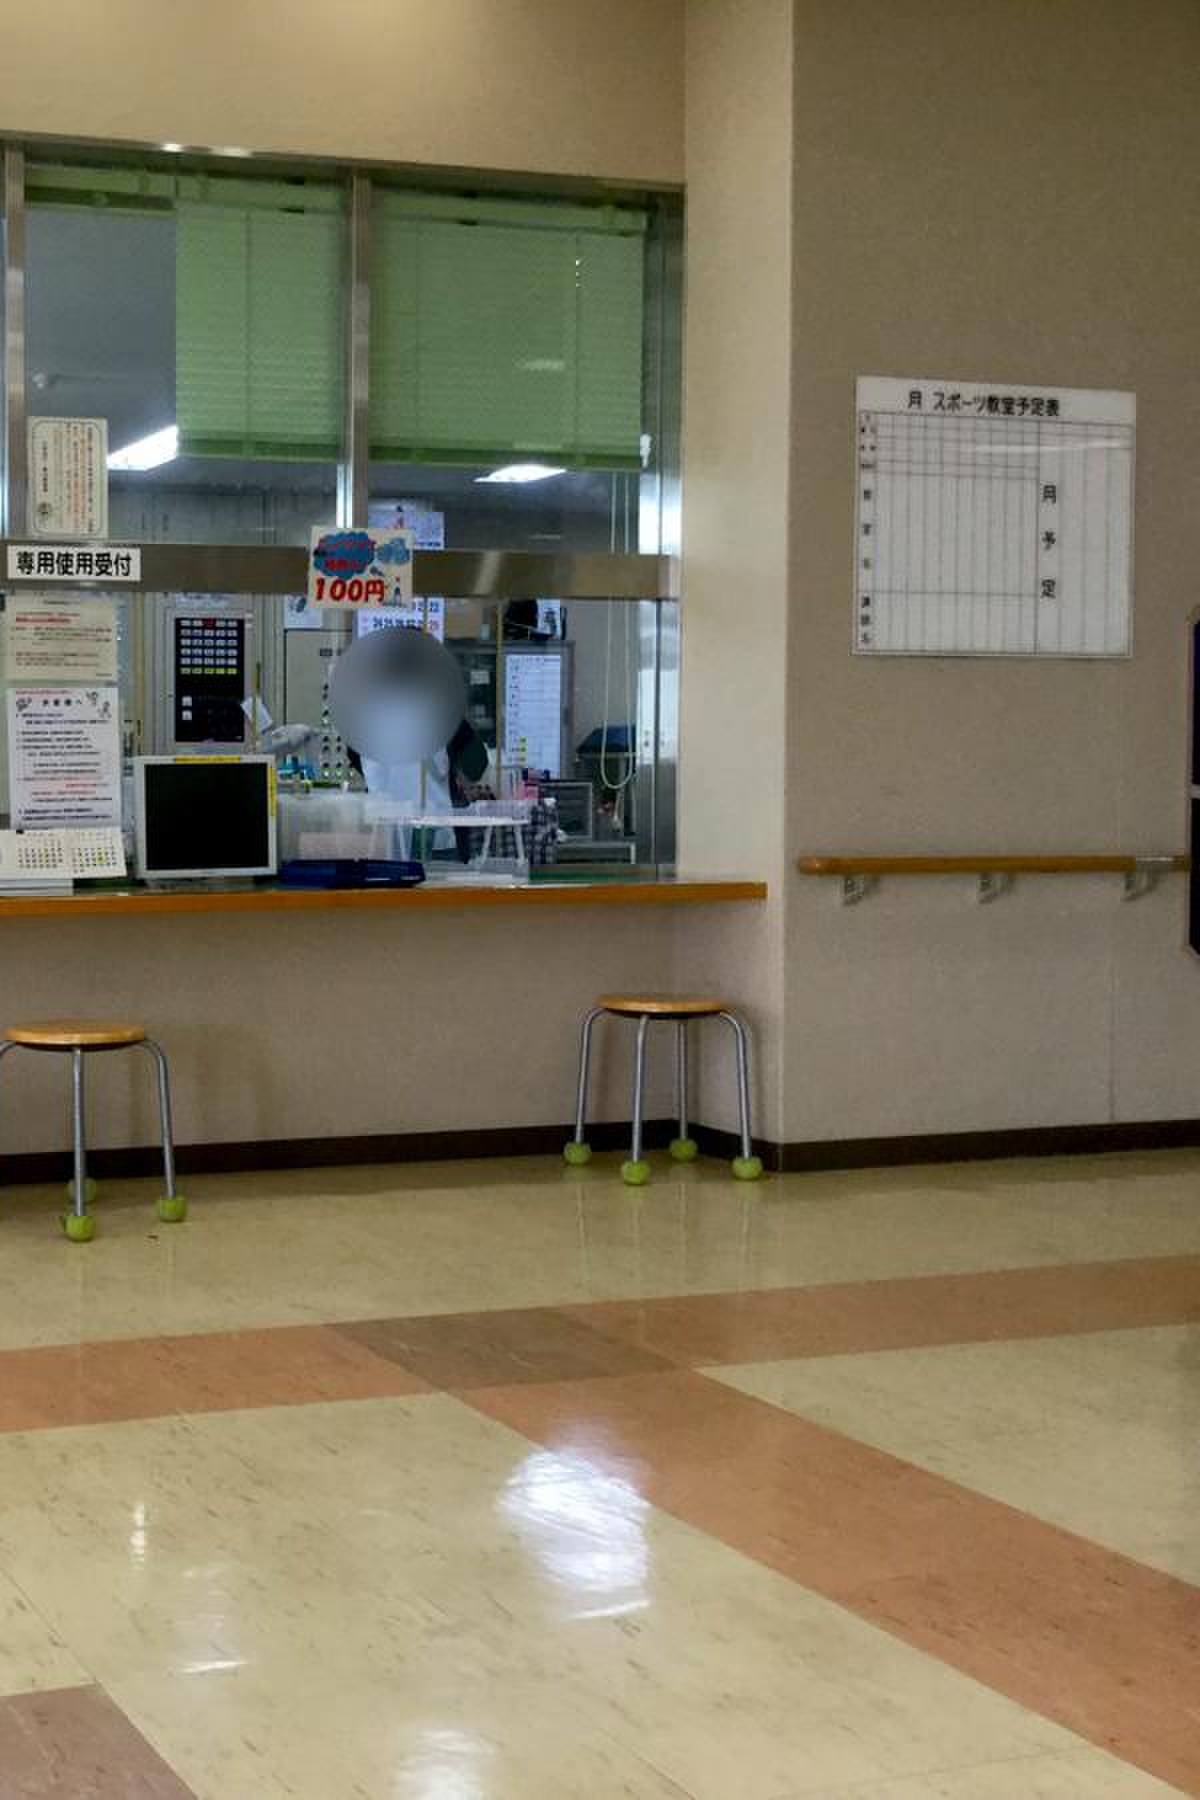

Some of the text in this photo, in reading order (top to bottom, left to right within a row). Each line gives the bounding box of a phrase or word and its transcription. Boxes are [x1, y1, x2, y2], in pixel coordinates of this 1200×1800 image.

[16, 550, 132, 577] 専用使用受付
[315, 577, 385, 602] 100円
